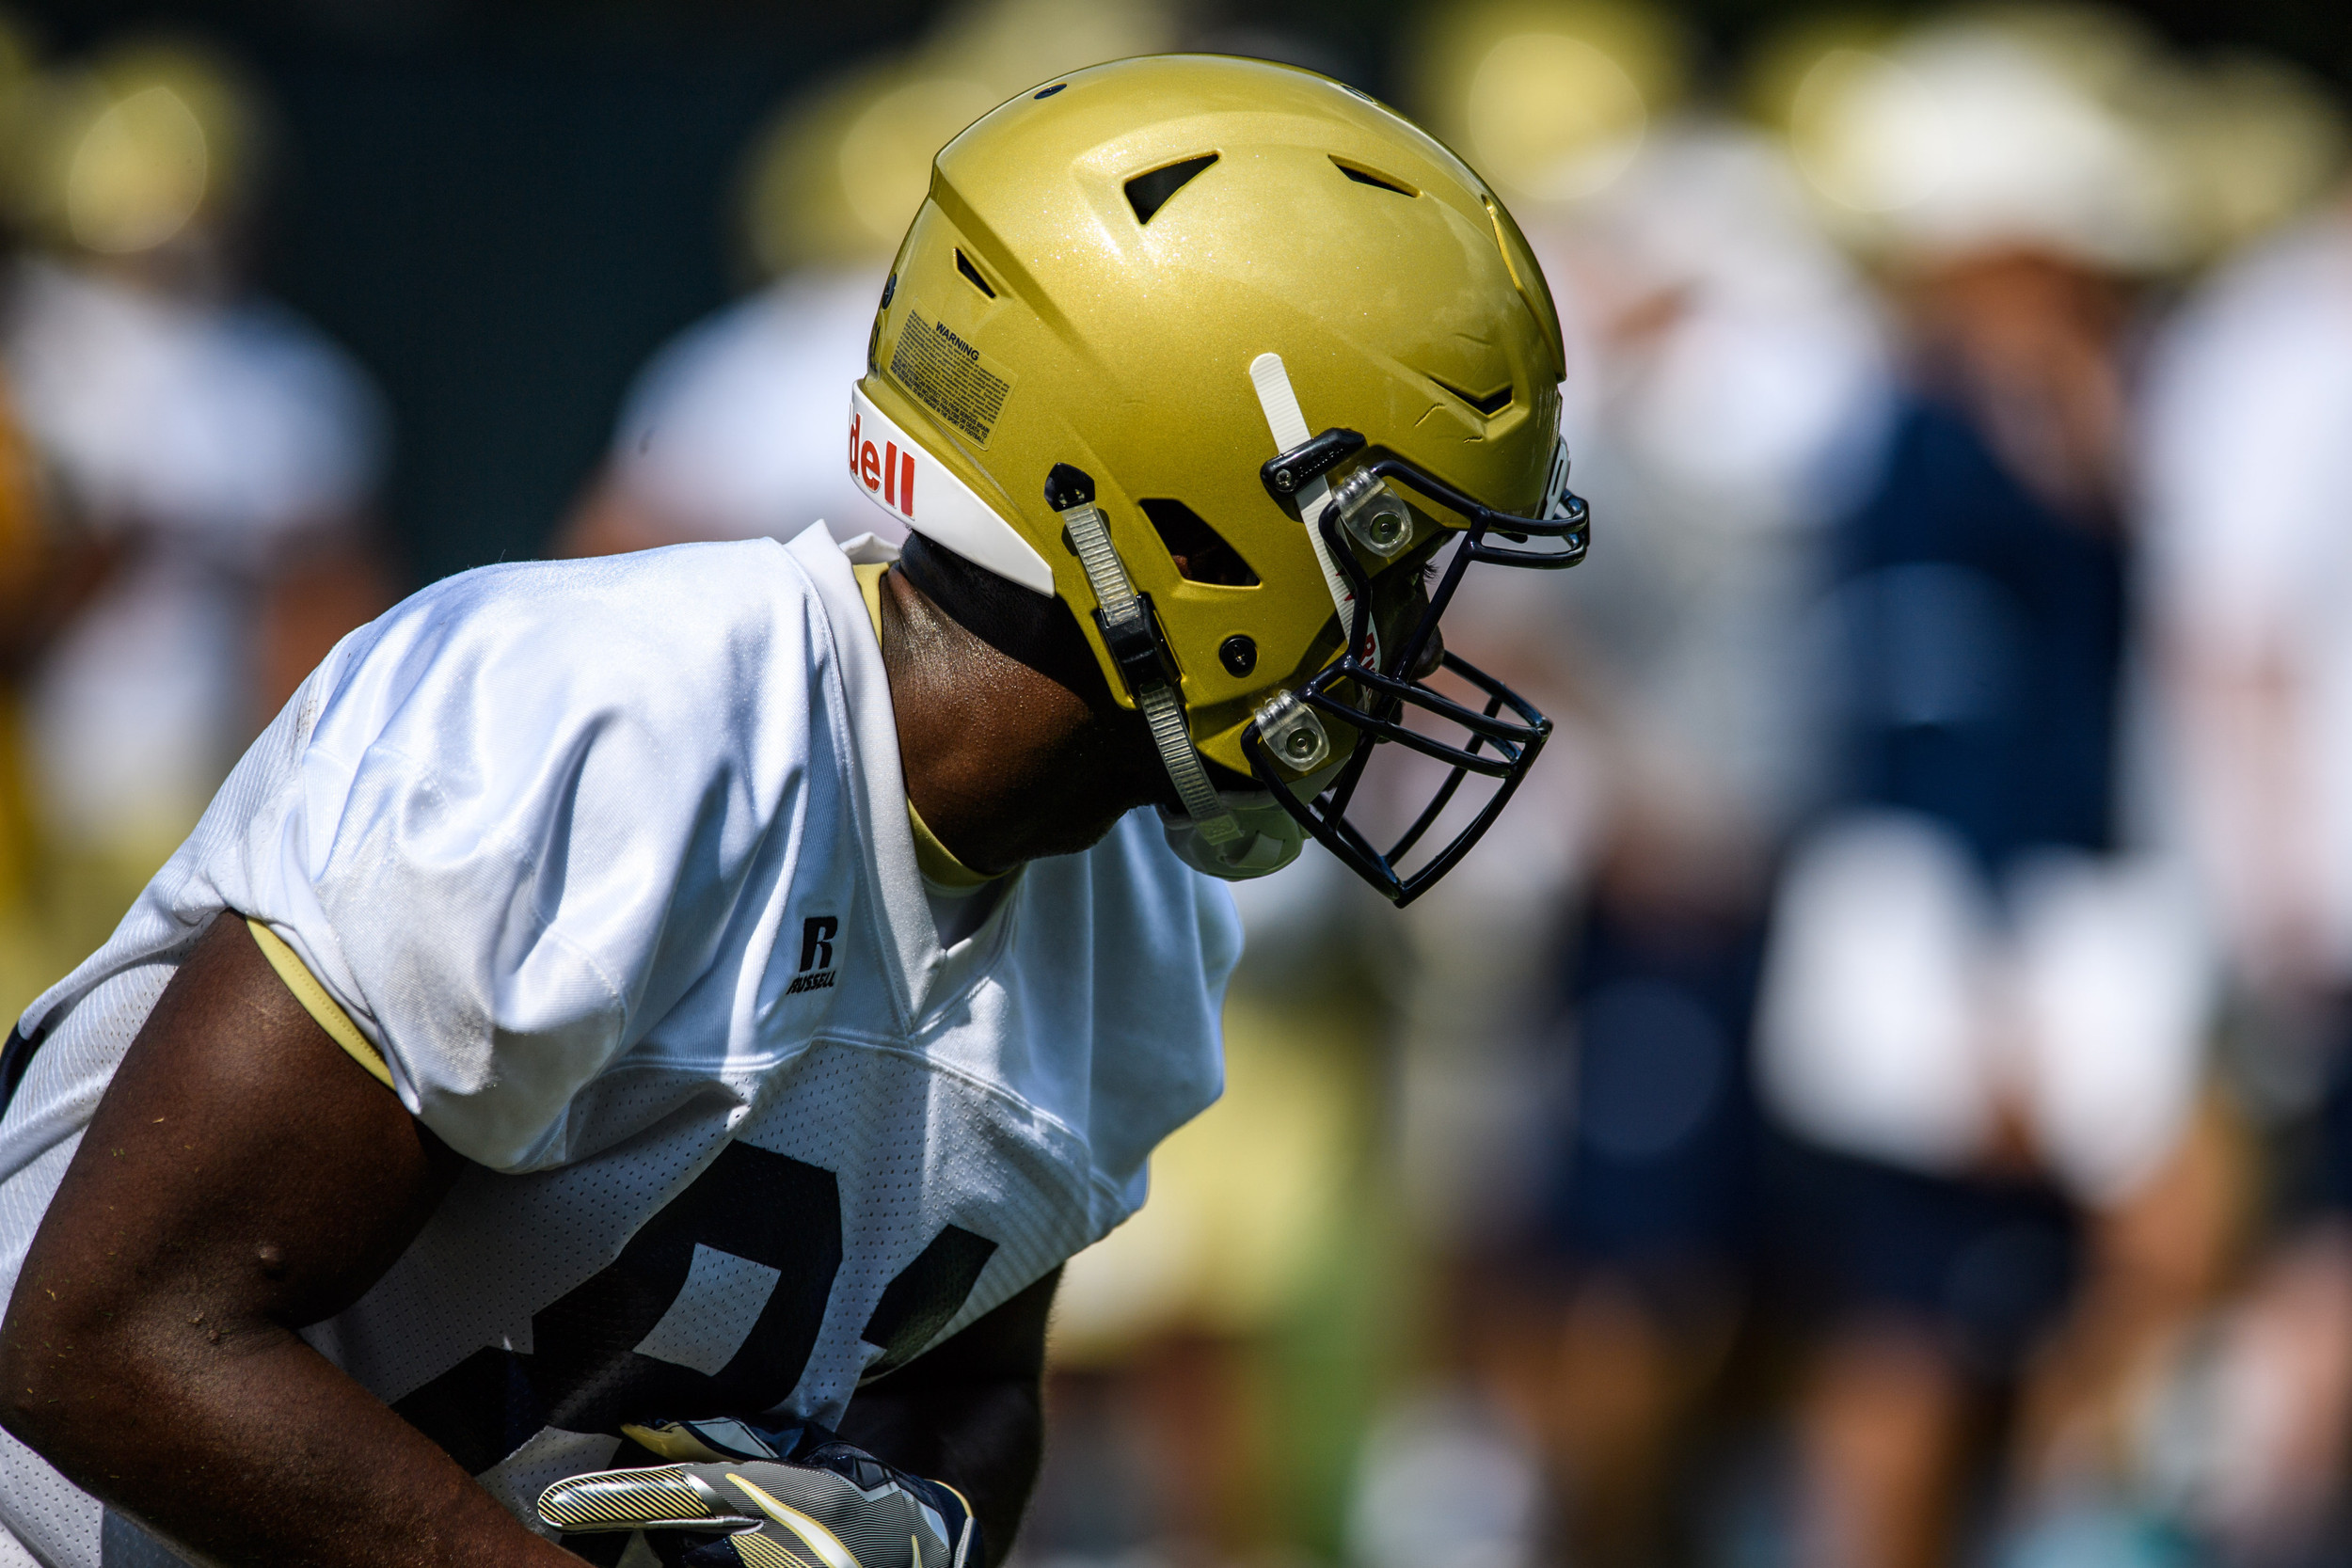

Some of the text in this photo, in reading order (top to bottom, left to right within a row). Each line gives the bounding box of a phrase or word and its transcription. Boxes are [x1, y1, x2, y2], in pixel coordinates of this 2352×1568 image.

[936, 321, 980, 361] WARNING
[799, 916, 838, 973] R
[786, 971, 836, 995] RUSSELL
